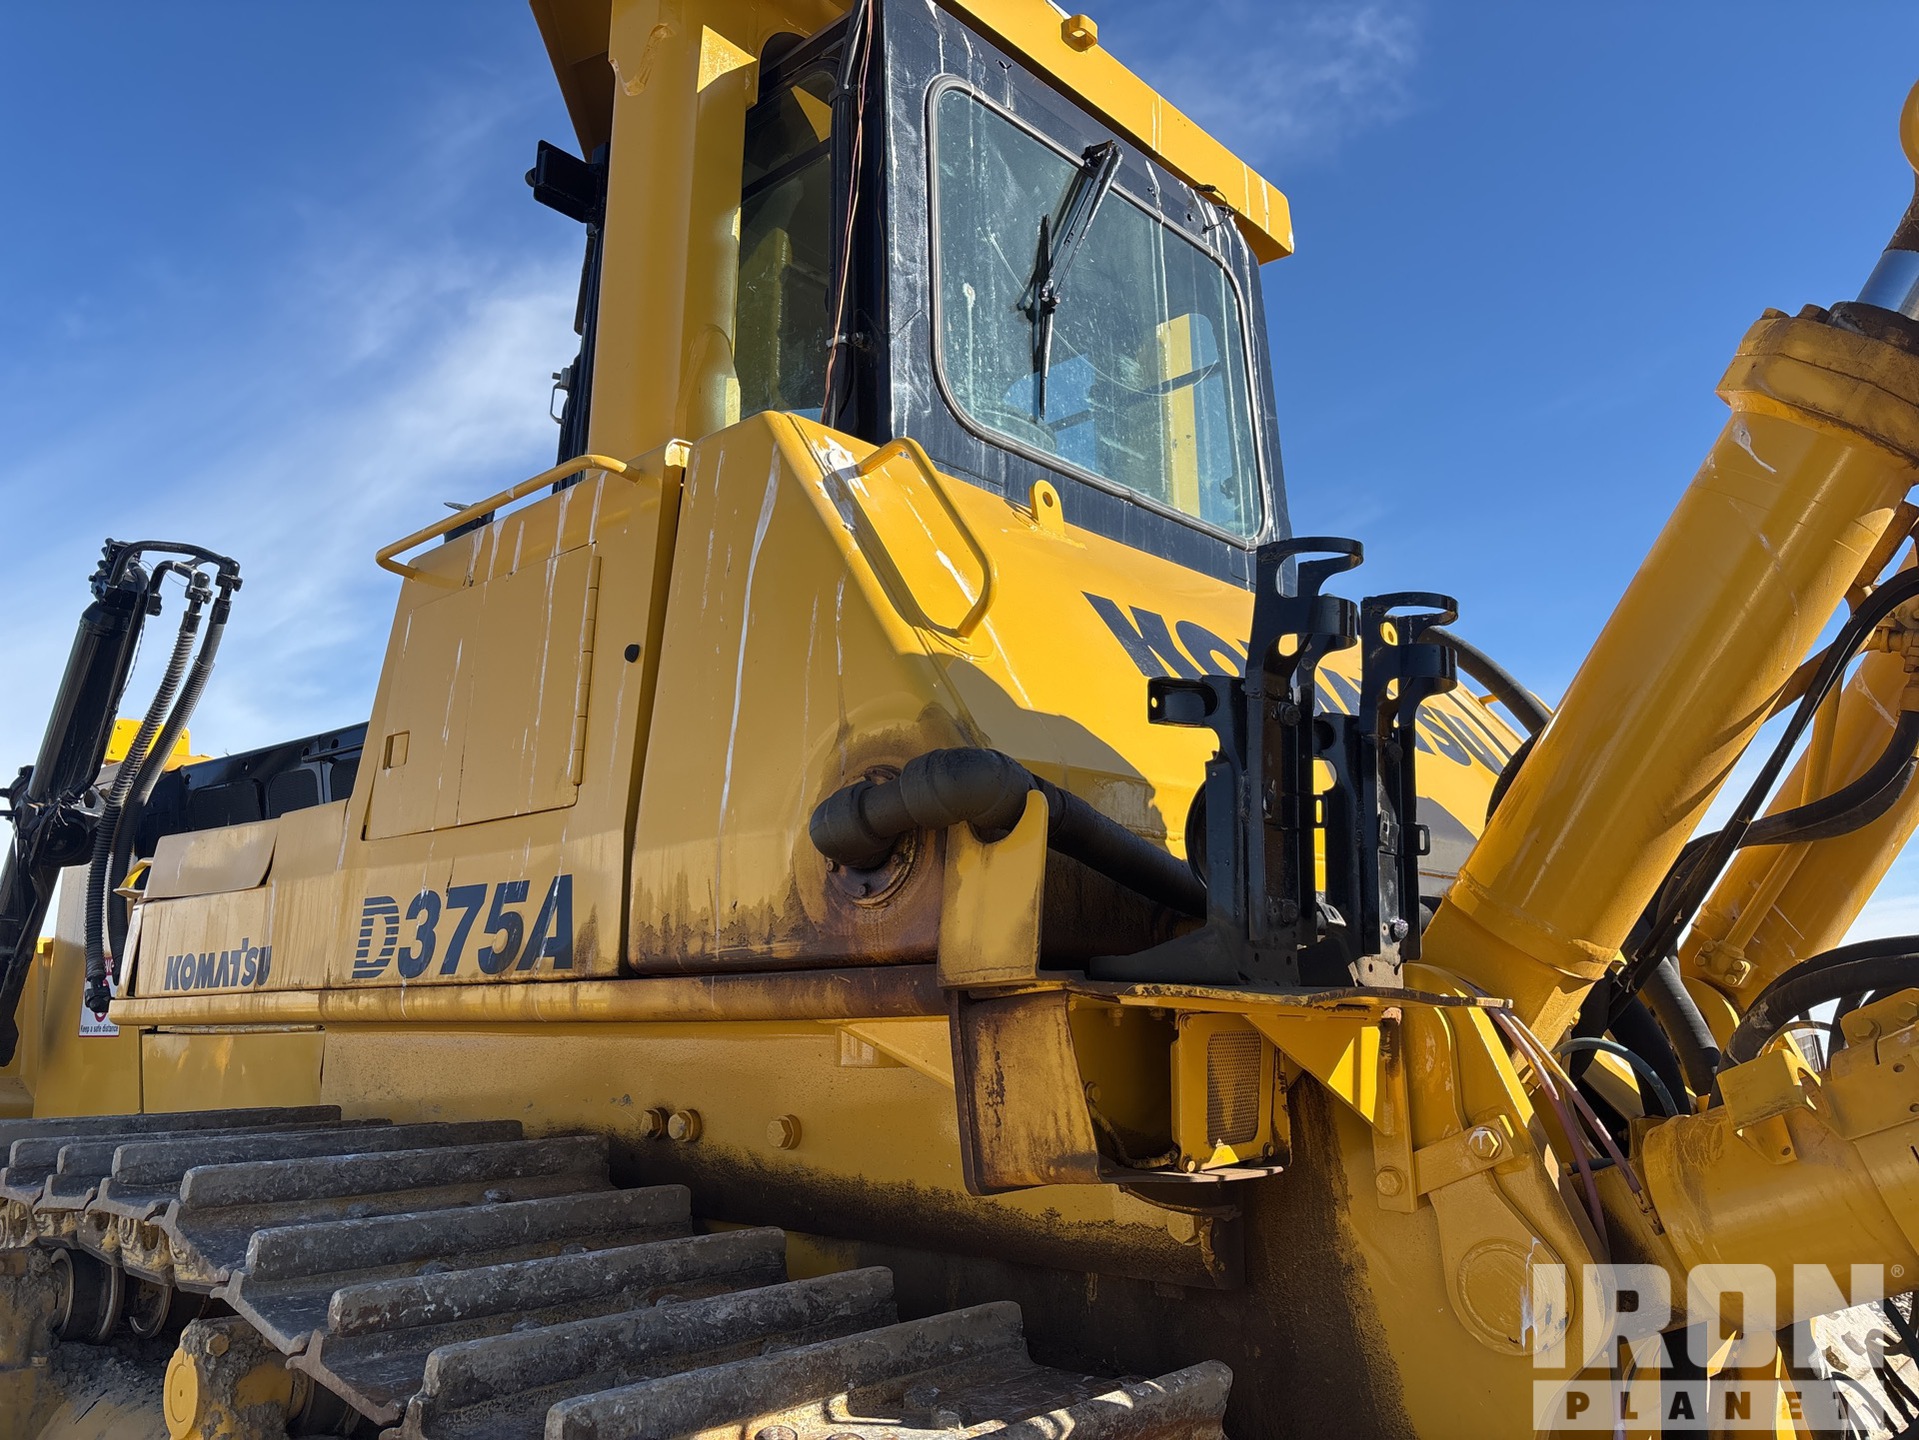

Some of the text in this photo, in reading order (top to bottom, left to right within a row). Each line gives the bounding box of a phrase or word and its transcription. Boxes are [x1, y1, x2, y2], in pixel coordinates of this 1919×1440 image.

[1082, 591, 1504, 777] KOSU
[164, 937, 272, 991] KOMATSU
[352, 874, 573, 979] D375A
[80, 1024, 89, 1034] Keep
[102, 1024, 118, 1032] distance
